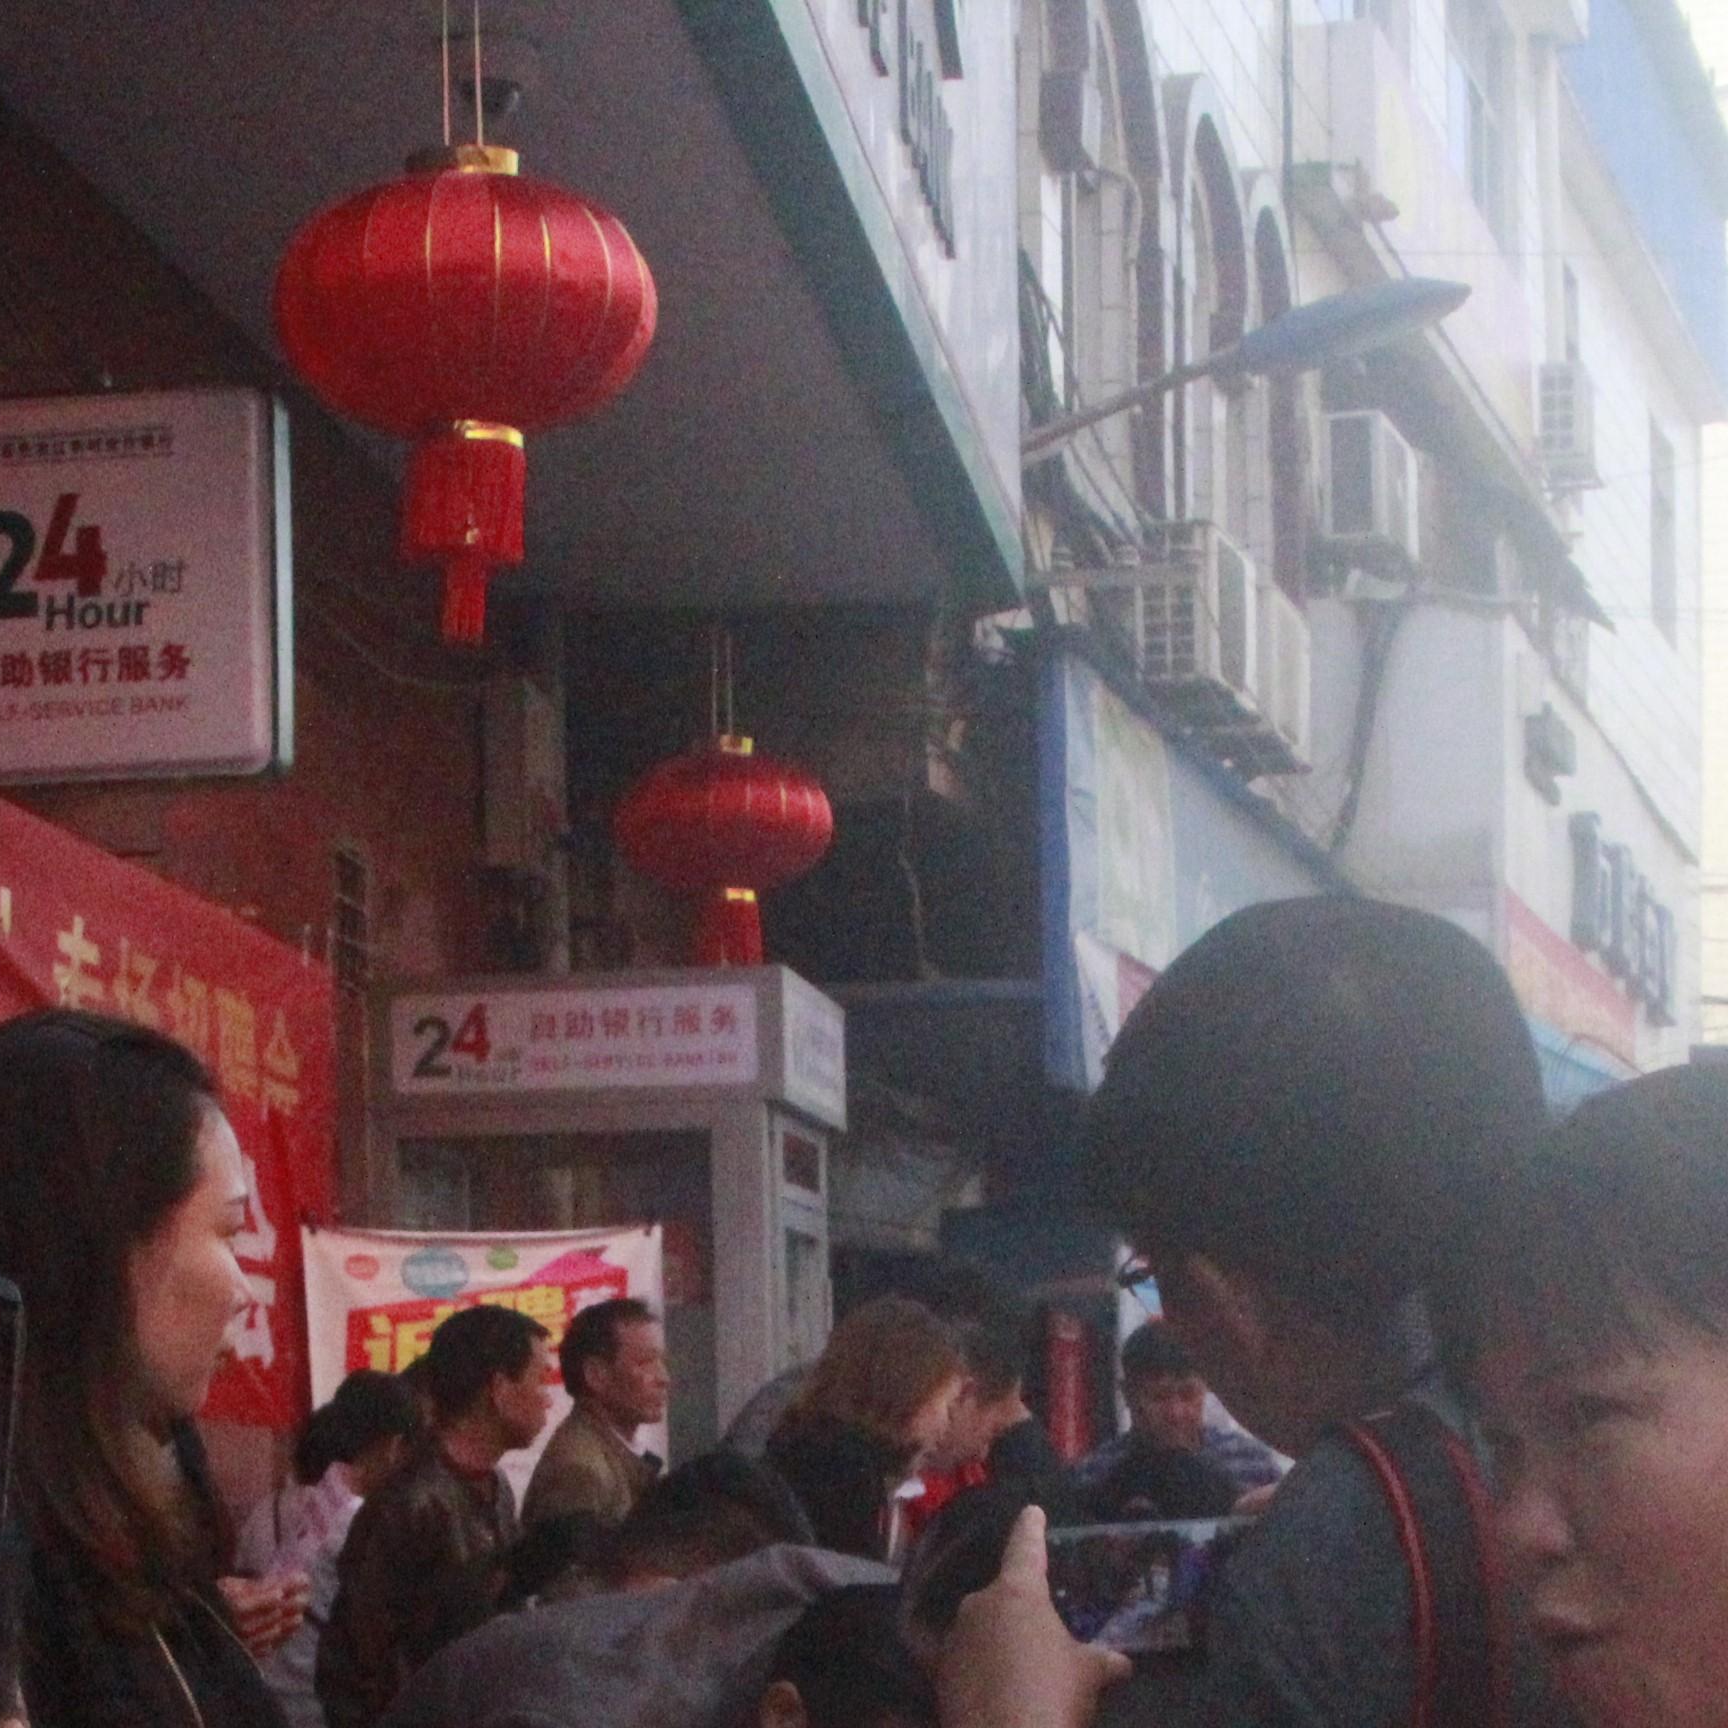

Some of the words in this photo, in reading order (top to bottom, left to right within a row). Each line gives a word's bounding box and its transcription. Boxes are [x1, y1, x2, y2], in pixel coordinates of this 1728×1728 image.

[113, 558, 187, 597] 小时
[45, 596, 150, 630] Hour
[413, 1002, 491, 1078] 24
